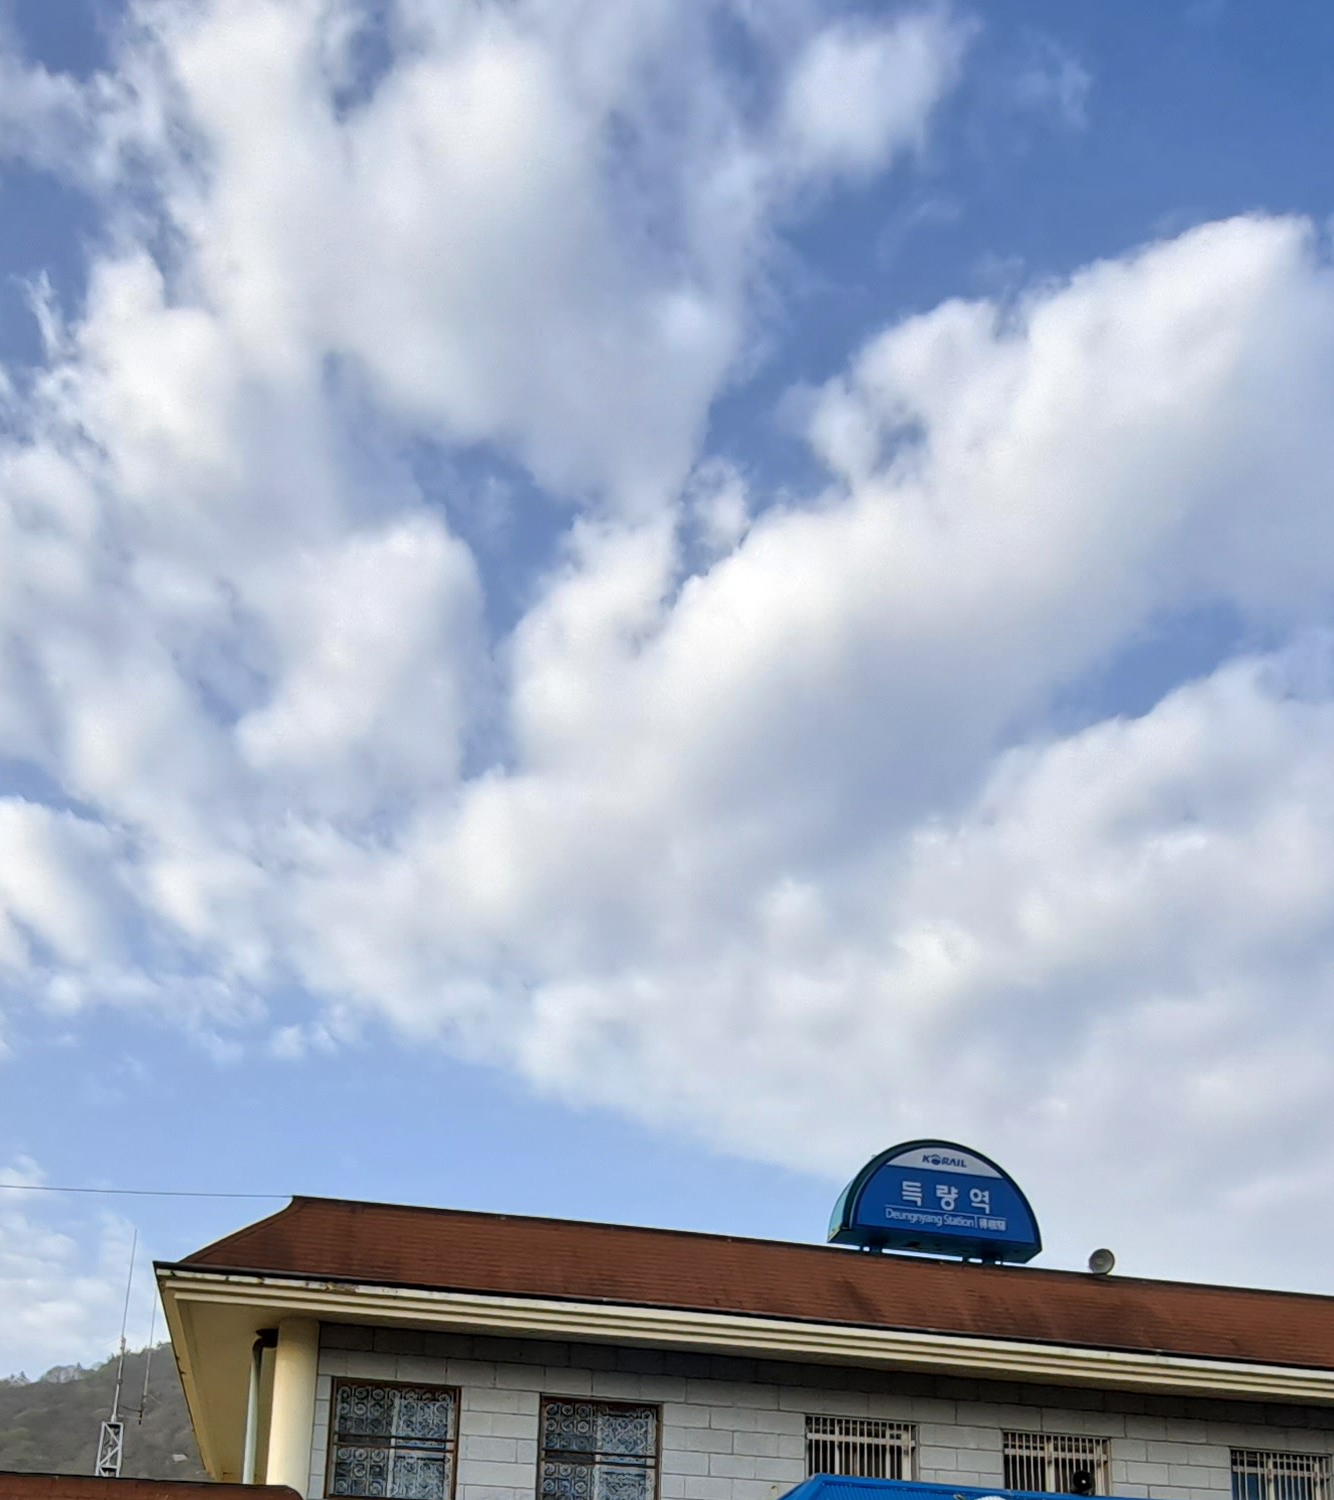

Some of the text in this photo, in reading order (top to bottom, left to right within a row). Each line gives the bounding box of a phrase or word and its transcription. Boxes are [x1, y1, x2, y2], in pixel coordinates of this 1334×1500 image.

[922, 1154, 967, 1168] KORAIL
[886, 1208, 943, 1227] Deungnyang
[943, 1214, 975, 1228] Station
